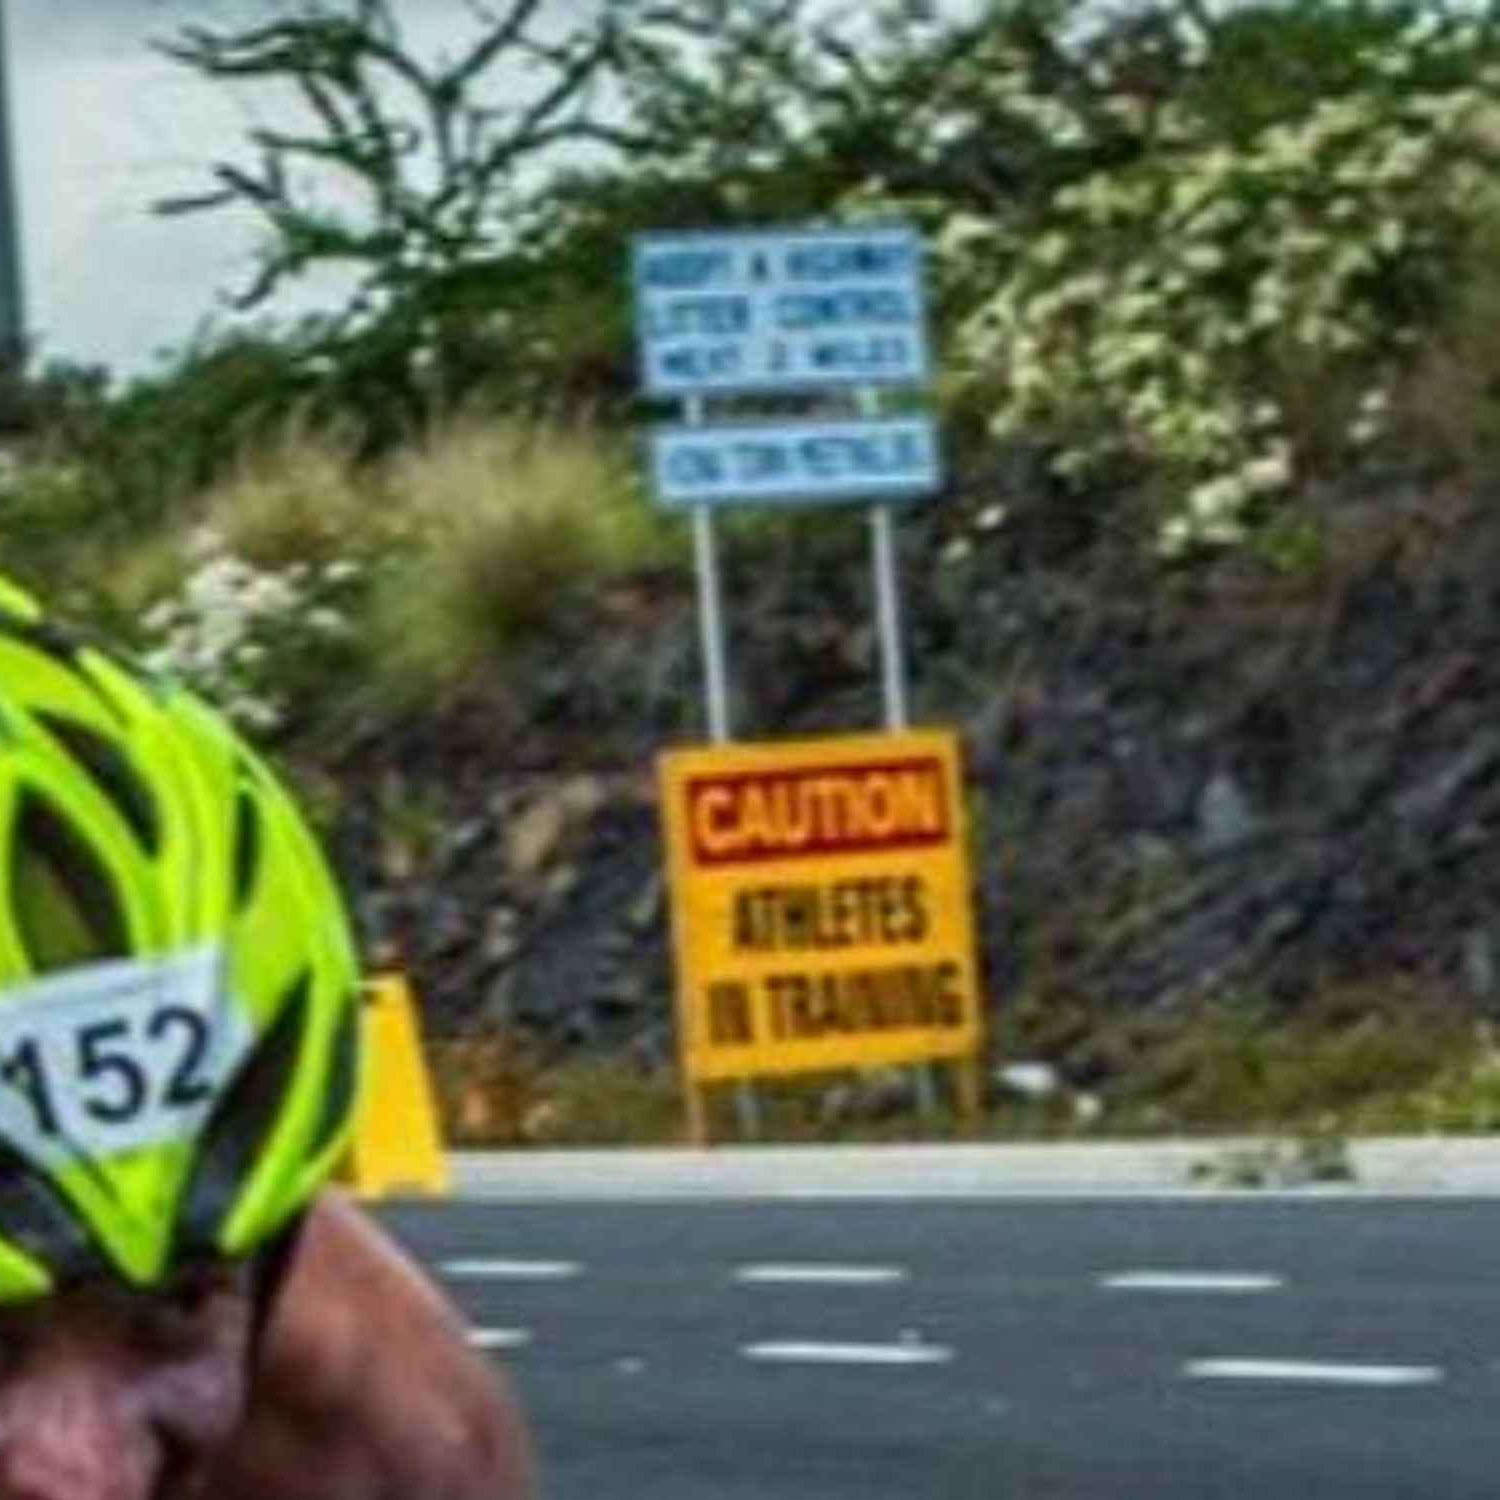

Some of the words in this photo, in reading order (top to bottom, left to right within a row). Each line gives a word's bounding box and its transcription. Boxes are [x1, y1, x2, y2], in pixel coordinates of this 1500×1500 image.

[696, 769, 941, 851] CAUTION
[733, 874, 928, 952] ATHLETES
[708, 980, 754, 1046] IN
[762, 962, 964, 1041] TRAINING
[0, 1004, 213, 1135] 152
